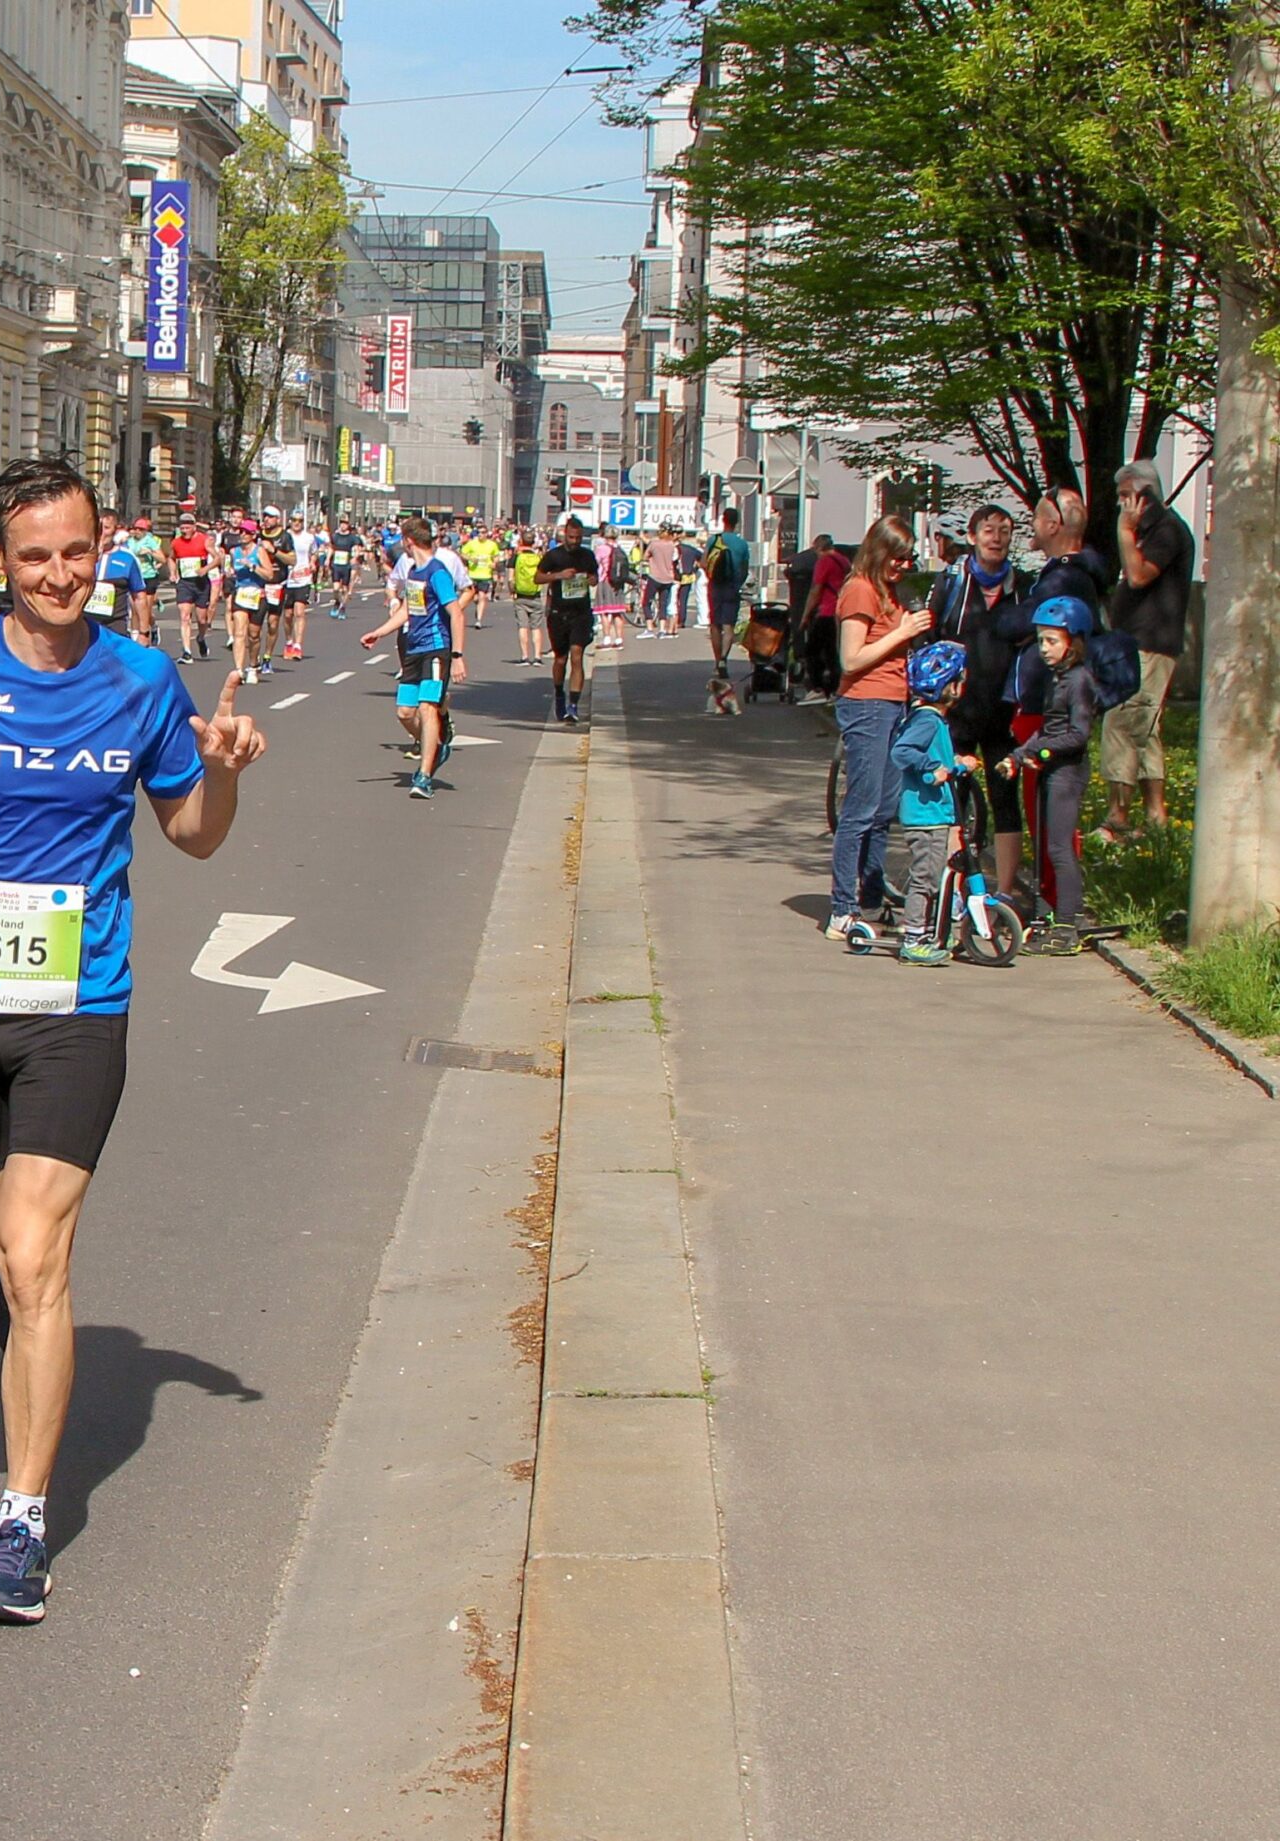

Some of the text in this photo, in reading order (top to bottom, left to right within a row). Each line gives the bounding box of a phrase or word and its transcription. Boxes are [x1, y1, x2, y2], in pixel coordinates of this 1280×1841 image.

[153, 243, 179, 360] Beinkofer
[392, 322, 406, 394] ATRIUM
[615, 506, 630, 523] P
[66, 749, 132, 773] AG
